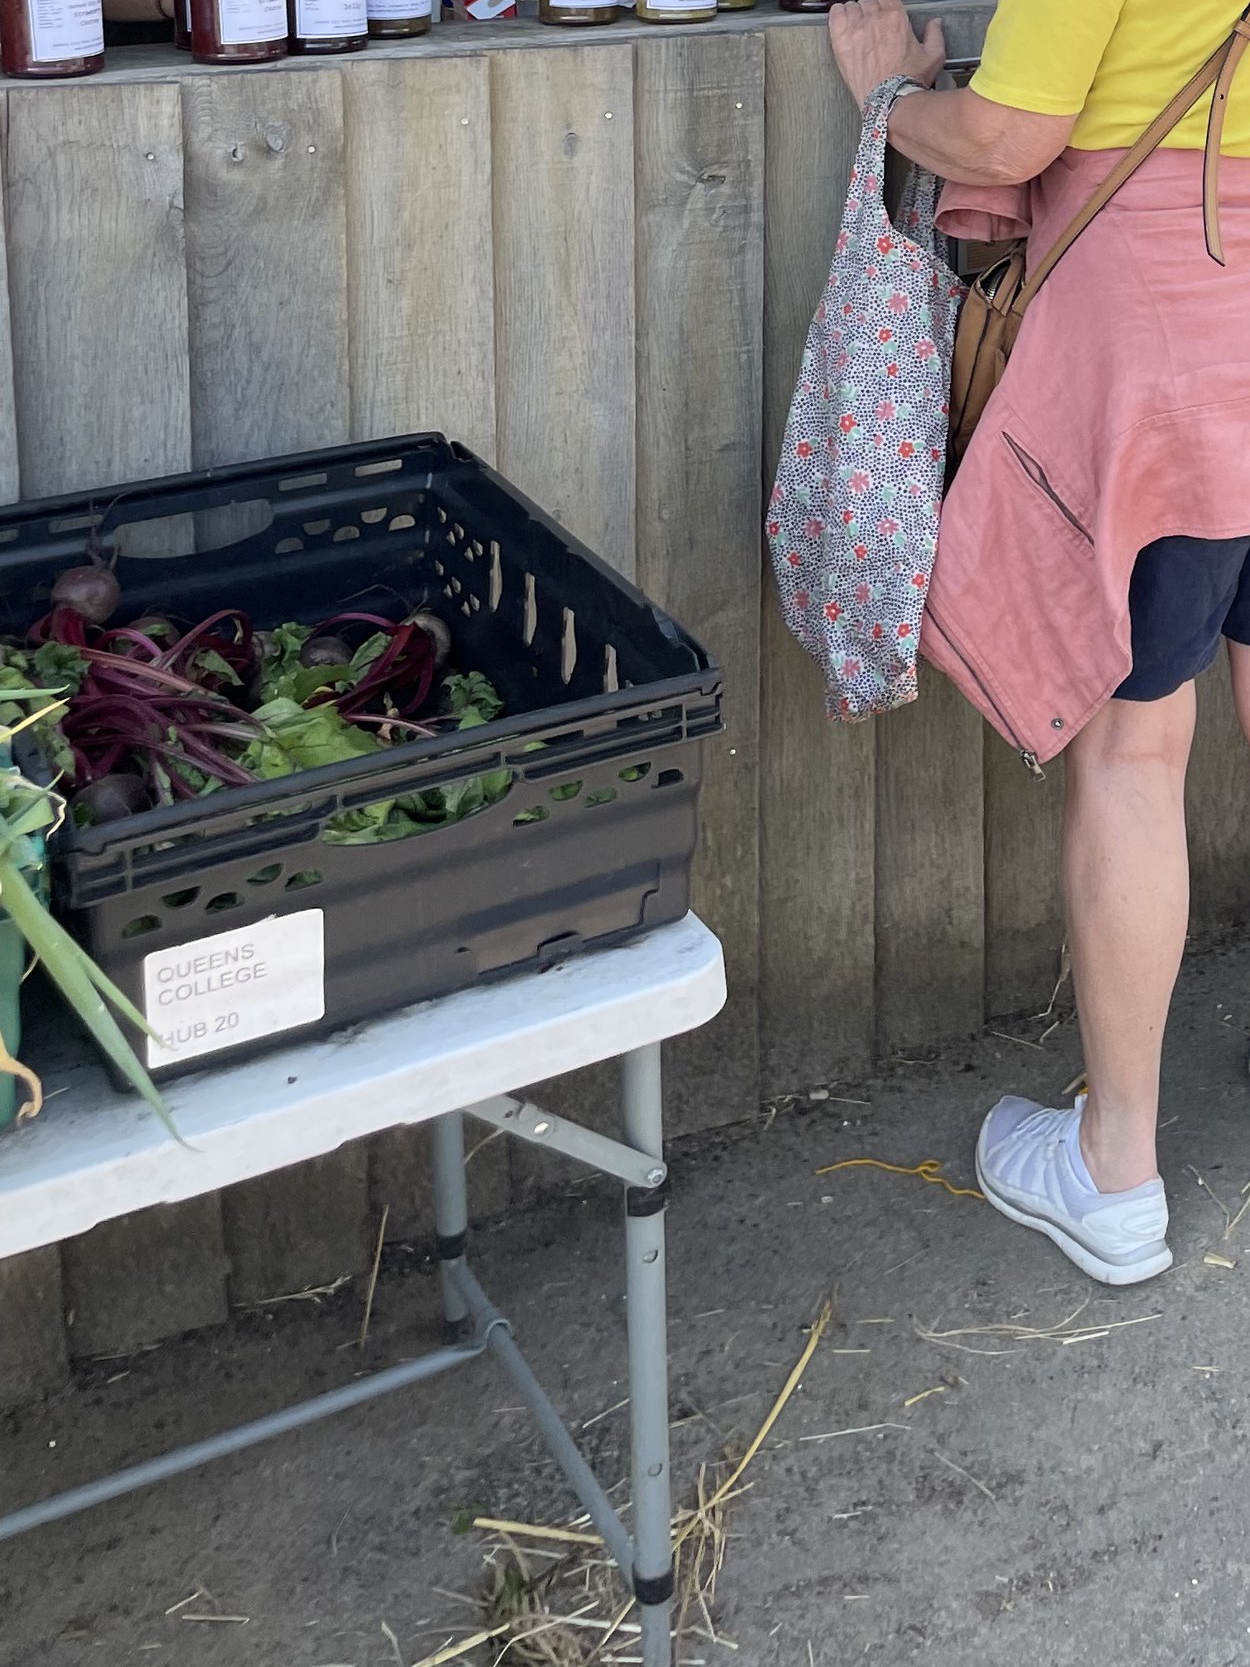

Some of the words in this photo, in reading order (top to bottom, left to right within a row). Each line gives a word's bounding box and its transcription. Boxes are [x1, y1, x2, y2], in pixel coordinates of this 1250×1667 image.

[157, 942, 256, 984] QUEENS
[158, 961, 267, 1006] COLLEGE
[160, 1021, 208, 1049] HUB
[215, 1011, 240, 1034] 20
